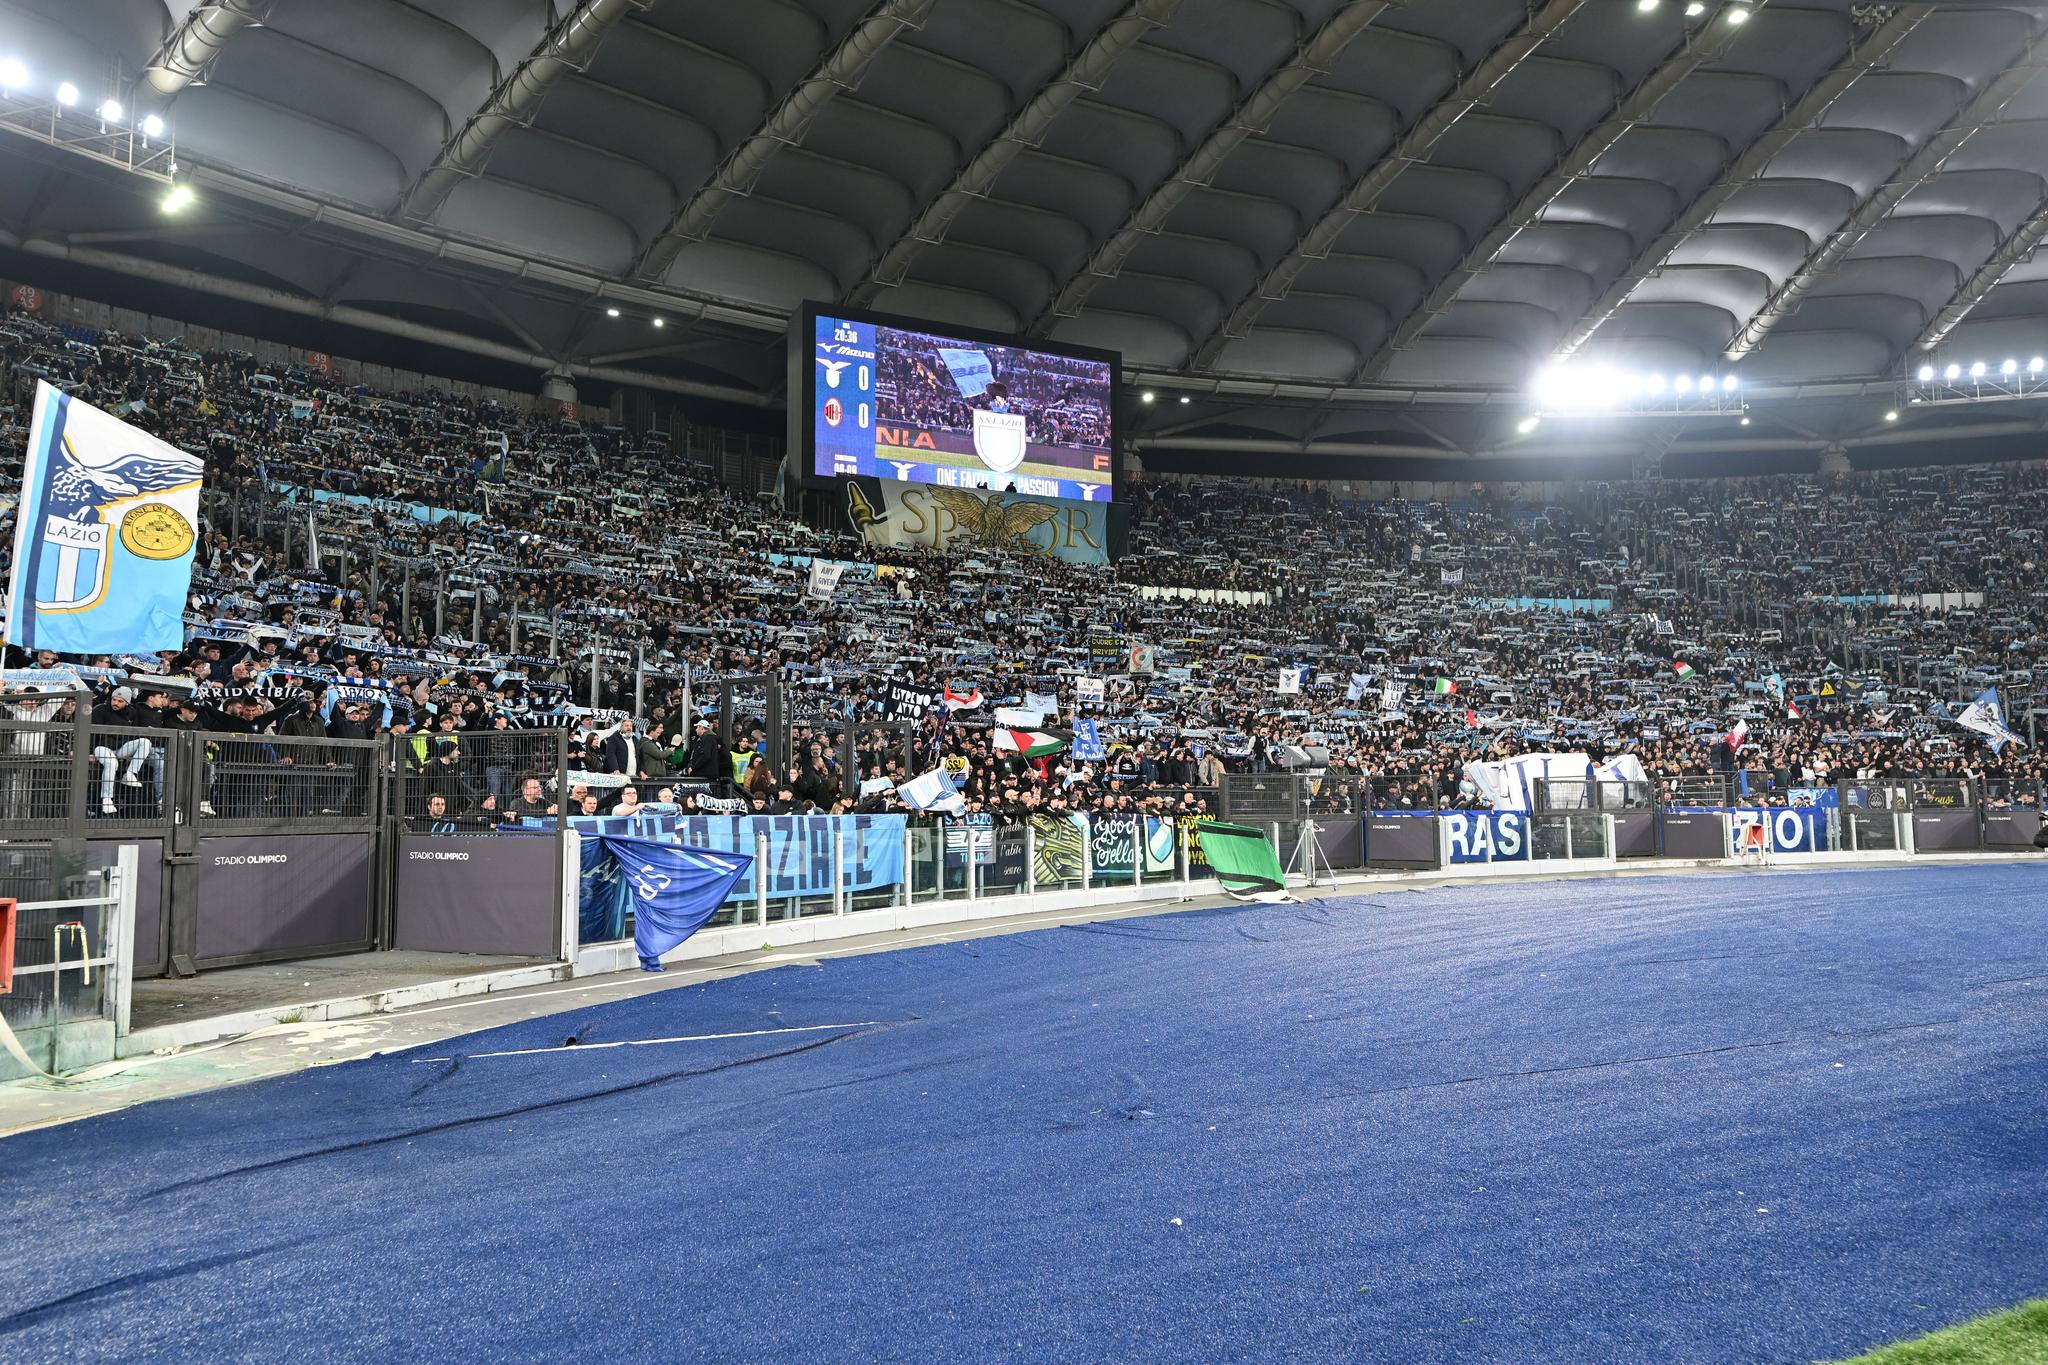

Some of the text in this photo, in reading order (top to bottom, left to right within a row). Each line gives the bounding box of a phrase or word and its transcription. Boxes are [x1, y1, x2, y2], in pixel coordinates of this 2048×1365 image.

[858, 365, 869, 391] 0
[858, 403, 869, 429] 0
[936, 467, 958, 486] ONE
[1017, 477, 1059, 498] PASSION
[125, 505, 149, 528] RIONE
[46, 522, 101, 543] LAZIO
[537, 656, 556, 665] LAZIO
[344, 687, 375, 700] LAZIO
[891, 686, 931, 707] ESTREMO
[895, 701, 921, 718] ATTO
[966, 812, 993, 825] LAZIO
[214, 854, 287, 866] STADIO OLIMPICO
[409, 851, 469, 861] STADIO OLIMPICO
